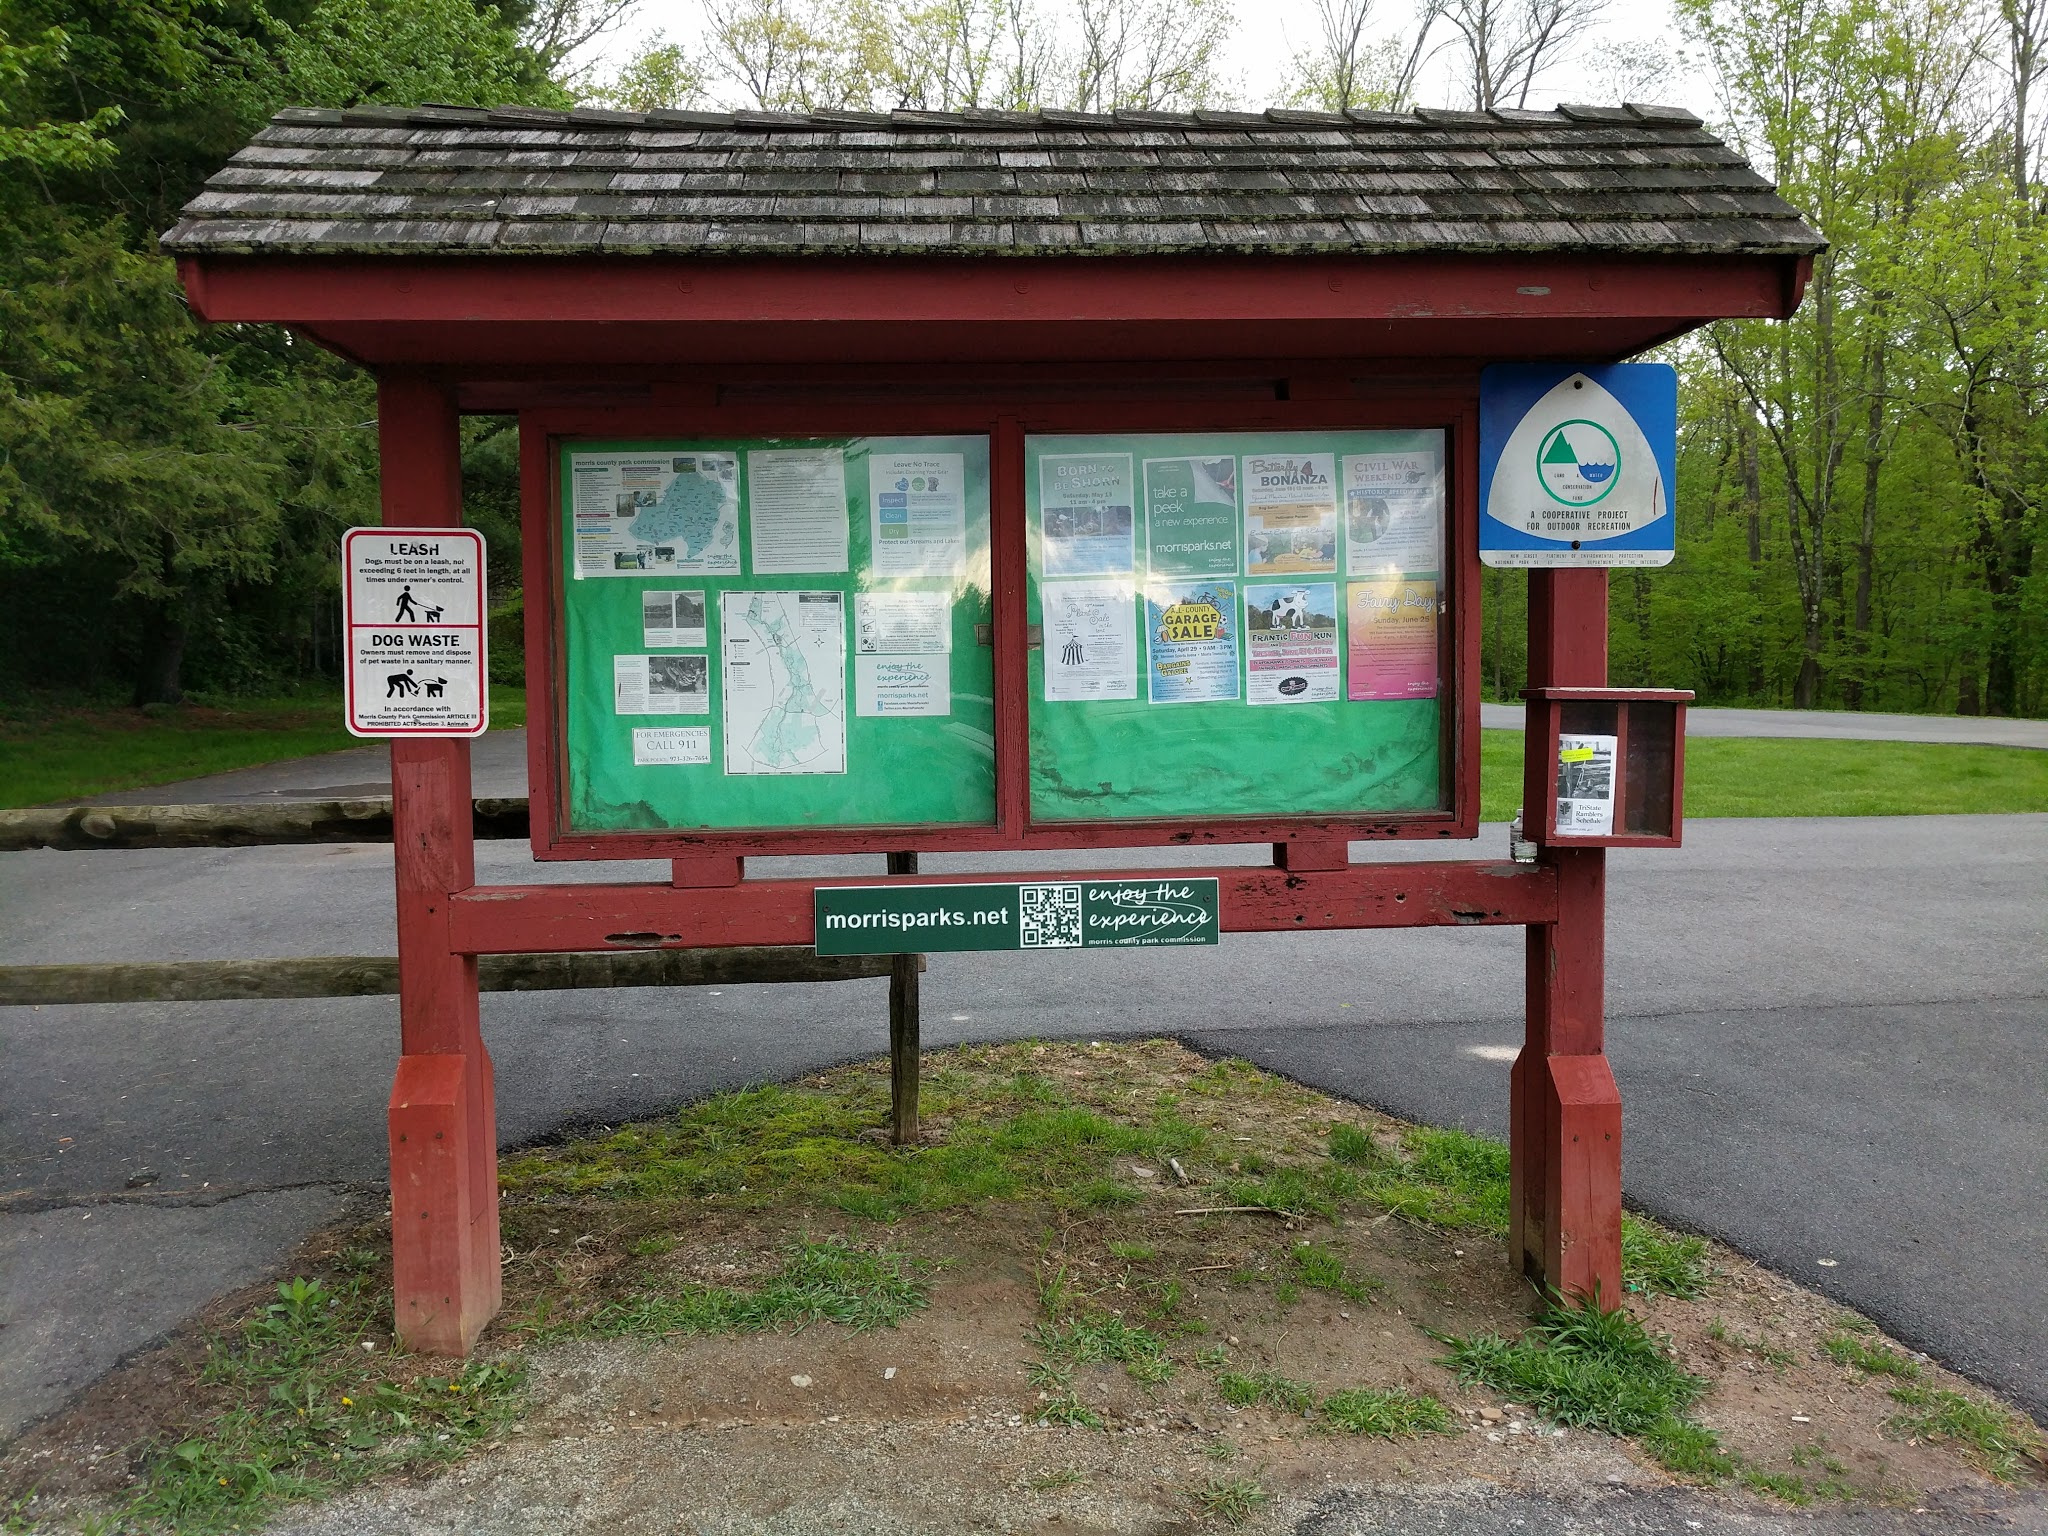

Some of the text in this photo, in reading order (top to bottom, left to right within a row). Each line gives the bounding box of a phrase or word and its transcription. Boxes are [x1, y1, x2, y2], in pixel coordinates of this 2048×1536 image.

[1057, 464, 1097, 477] BORN
[1249, 460, 1298, 477] Butterfly
[1355, 460, 1419, 472] CIVIL WAR
[1261, 475, 1327, 486] BONANZA
[1354, 473, 1402, 482] WEEKEND
[1054, 476, 1120, 491] BE SHORN
[1153, 485, 1187, 498] take a
[1153, 500, 1184, 517] peek
[1531, 511, 1628, 519] A COOPERATIVE PROJECT
[1155, 516, 1228, 527] a new experience
[1527, 522, 1631, 530] FOR OUTDOOR RECREATION
[390, 543, 439, 555] LEASH
[1156, 540, 1231, 554] morrisparks.net
[1357, 588, 1435, 614] Fairy Day
[1165, 614, 1217, 624] GARAGE
[1172, 625, 1213, 639] SALE
[1290, 631, 1312, 641] FUN
[372, 635, 460, 646] DOG WASTE
[877, 662, 902, 672] enjoy
[1156, 660, 1192, 671] BARGAINS
[877, 673, 931, 682] experience
[1161, 668, 1188, 677] GALORE
[647, 740, 696, 750] CALL 911
[1089, 883, 1195, 906] enjoy the
[826, 906, 1008, 931] morrisparks.net
[1089, 908, 1212, 931] experience
[1142, 936, 1159, 945] park
